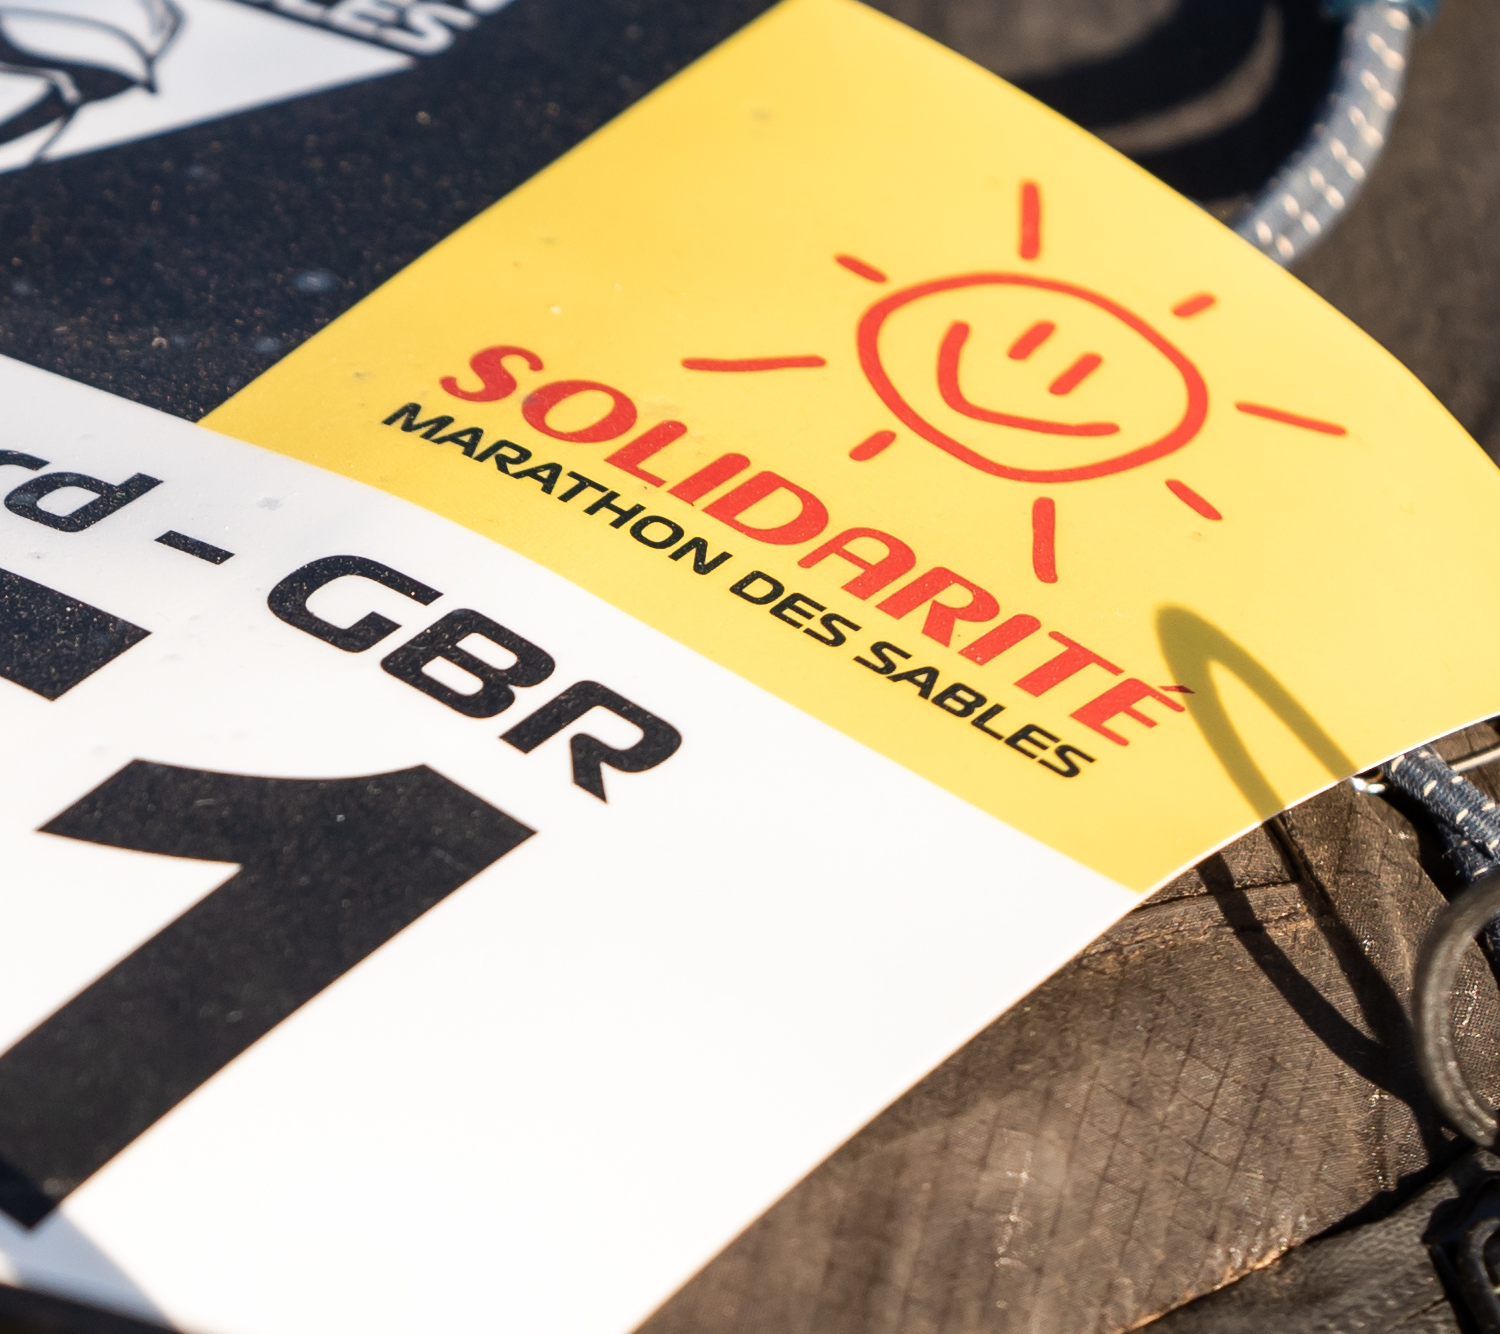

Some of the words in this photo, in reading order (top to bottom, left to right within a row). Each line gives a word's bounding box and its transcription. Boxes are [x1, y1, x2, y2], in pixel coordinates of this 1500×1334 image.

[154, 529, 236, 566] -
[265, 553, 684, 805] GBR
[381, 401, 733, 577] MARATHON
[728, 568, 863, 650] DES
[853, 639, 1097, 780] SABLES
[438, 344, 1196, 748] SOLIDARITÉ
